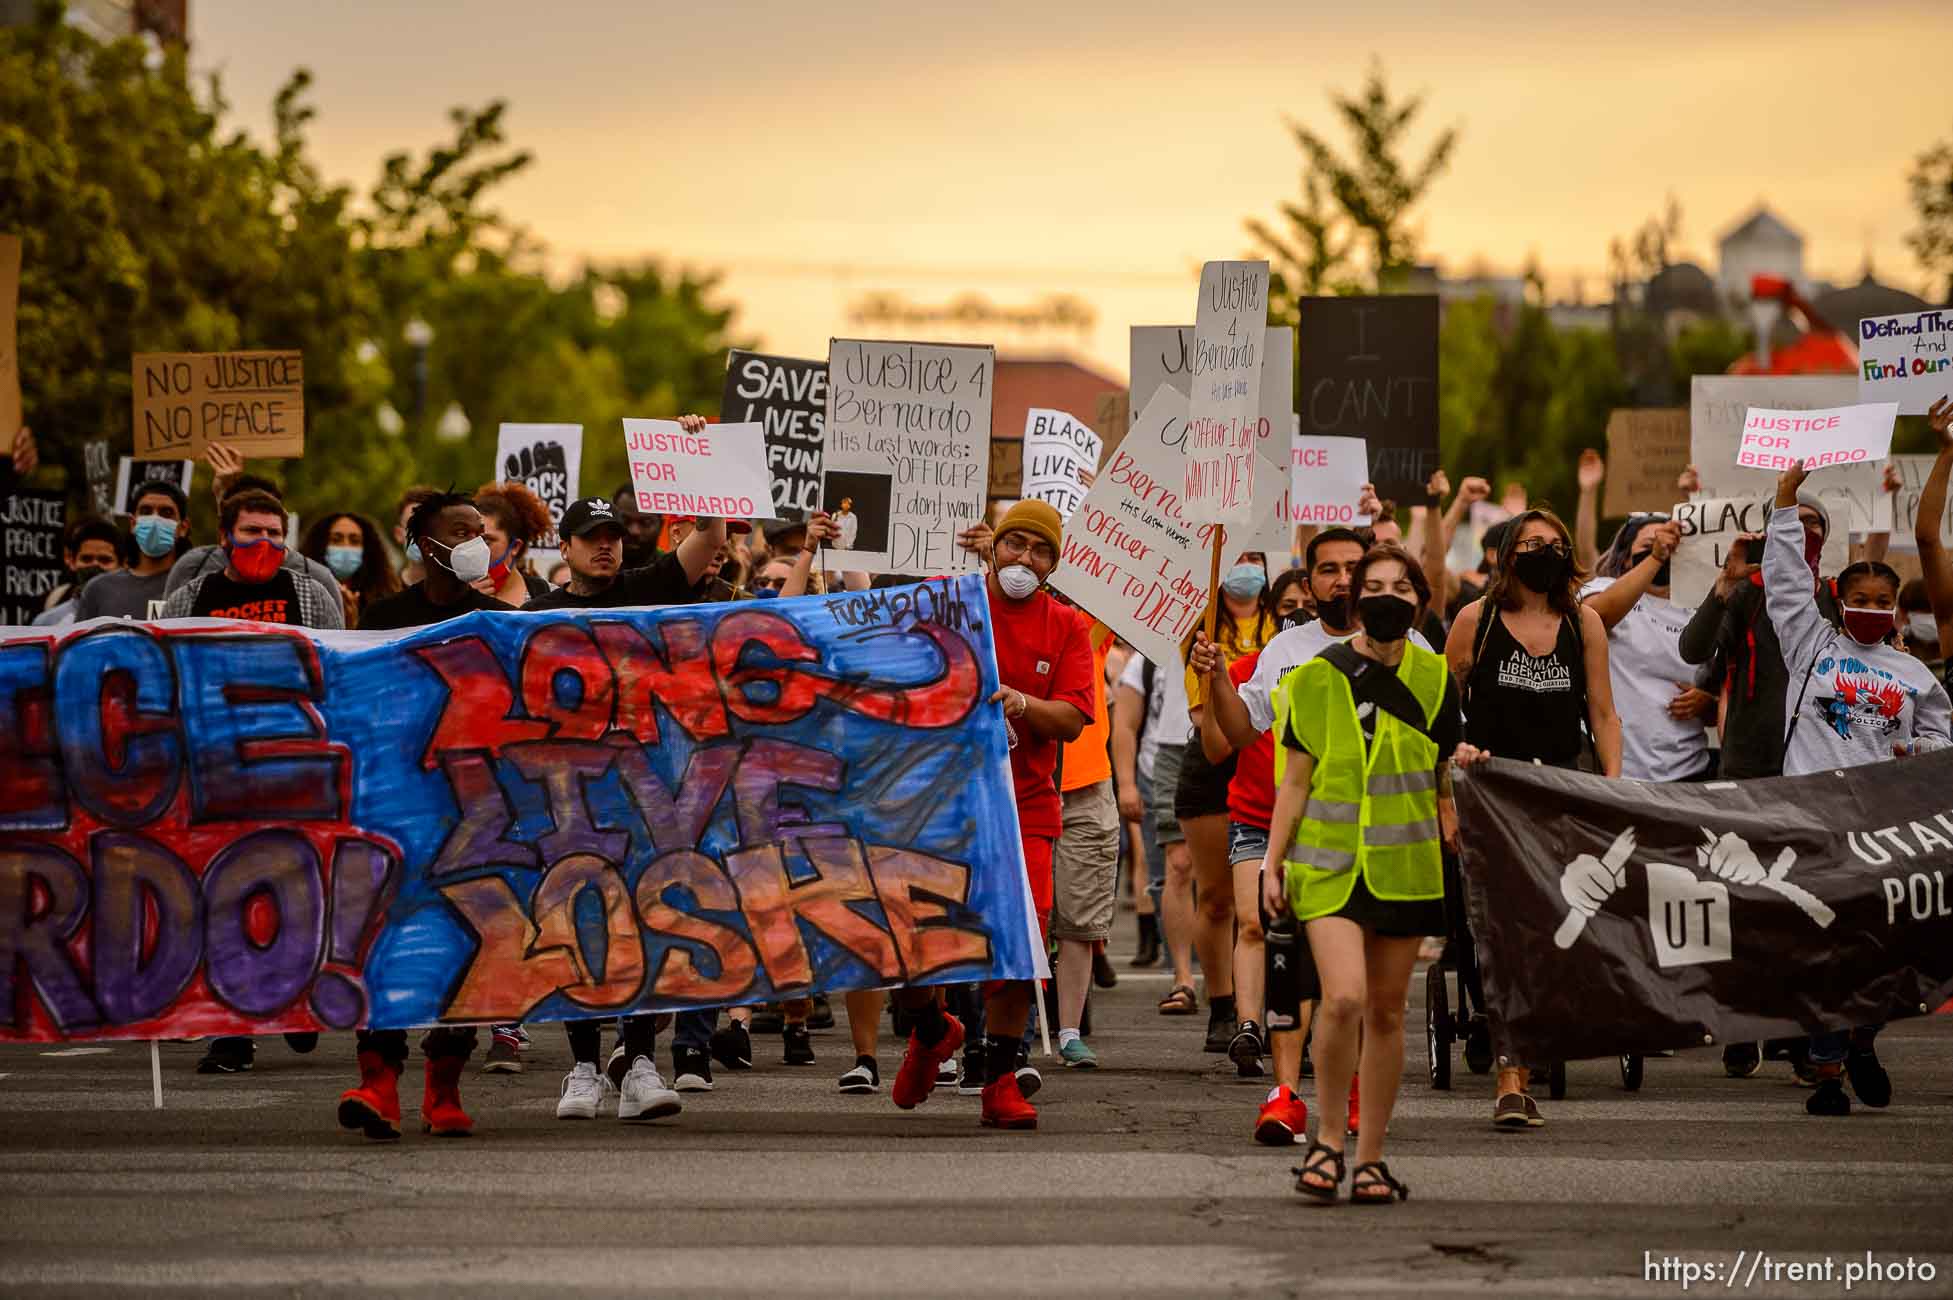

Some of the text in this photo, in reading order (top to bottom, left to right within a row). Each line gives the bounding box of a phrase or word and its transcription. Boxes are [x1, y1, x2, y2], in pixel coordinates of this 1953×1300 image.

[1227, 316, 1237, 345] 4
[1348, 306, 1381, 361] I
[1861, 317, 1922, 340] Defund
[1912, 333, 1946, 353] And
[845, 343, 985, 398] Justice 4
[1194, 335, 1254, 377] Bernardo
[1863, 357, 1951, 381] Fund Our
[145, 356, 301, 397] NO JUSTICE
[736, 359, 827, 406] SAVE
[145, 401, 286, 449] NO PEACE
[832, 384, 972, 438] Bernardo
[1747, 415, 1841, 433] JUSTICE
[629, 432, 713, 457] JUSTICE
[832, 430, 862, 452] His
[1033, 416, 1097, 459] BLACK
[1743, 433, 1791, 449] FOR
[633, 463, 677, 481] FOR
[766, 443, 823, 475] FUN
[638, 492, 755, 516] BERNARDO
[769, 473, 819, 513] OLIC
[0, 494, 65, 527] JUSTICE
[4, 527, 57, 560] PEACE
[1060, 533, 1122, 586] WANT
[5, 564, 62, 598] RACIST
[824, 590, 882, 627] FUCK
[1499, 660, 1570, 682] LIBERATION
[1510, 650, 1561, 671] ANIMAL
[414, 610, 982, 770] LONG
[428, 730, 848, 880] LIVE
[1665, 898, 1716, 949] UT
